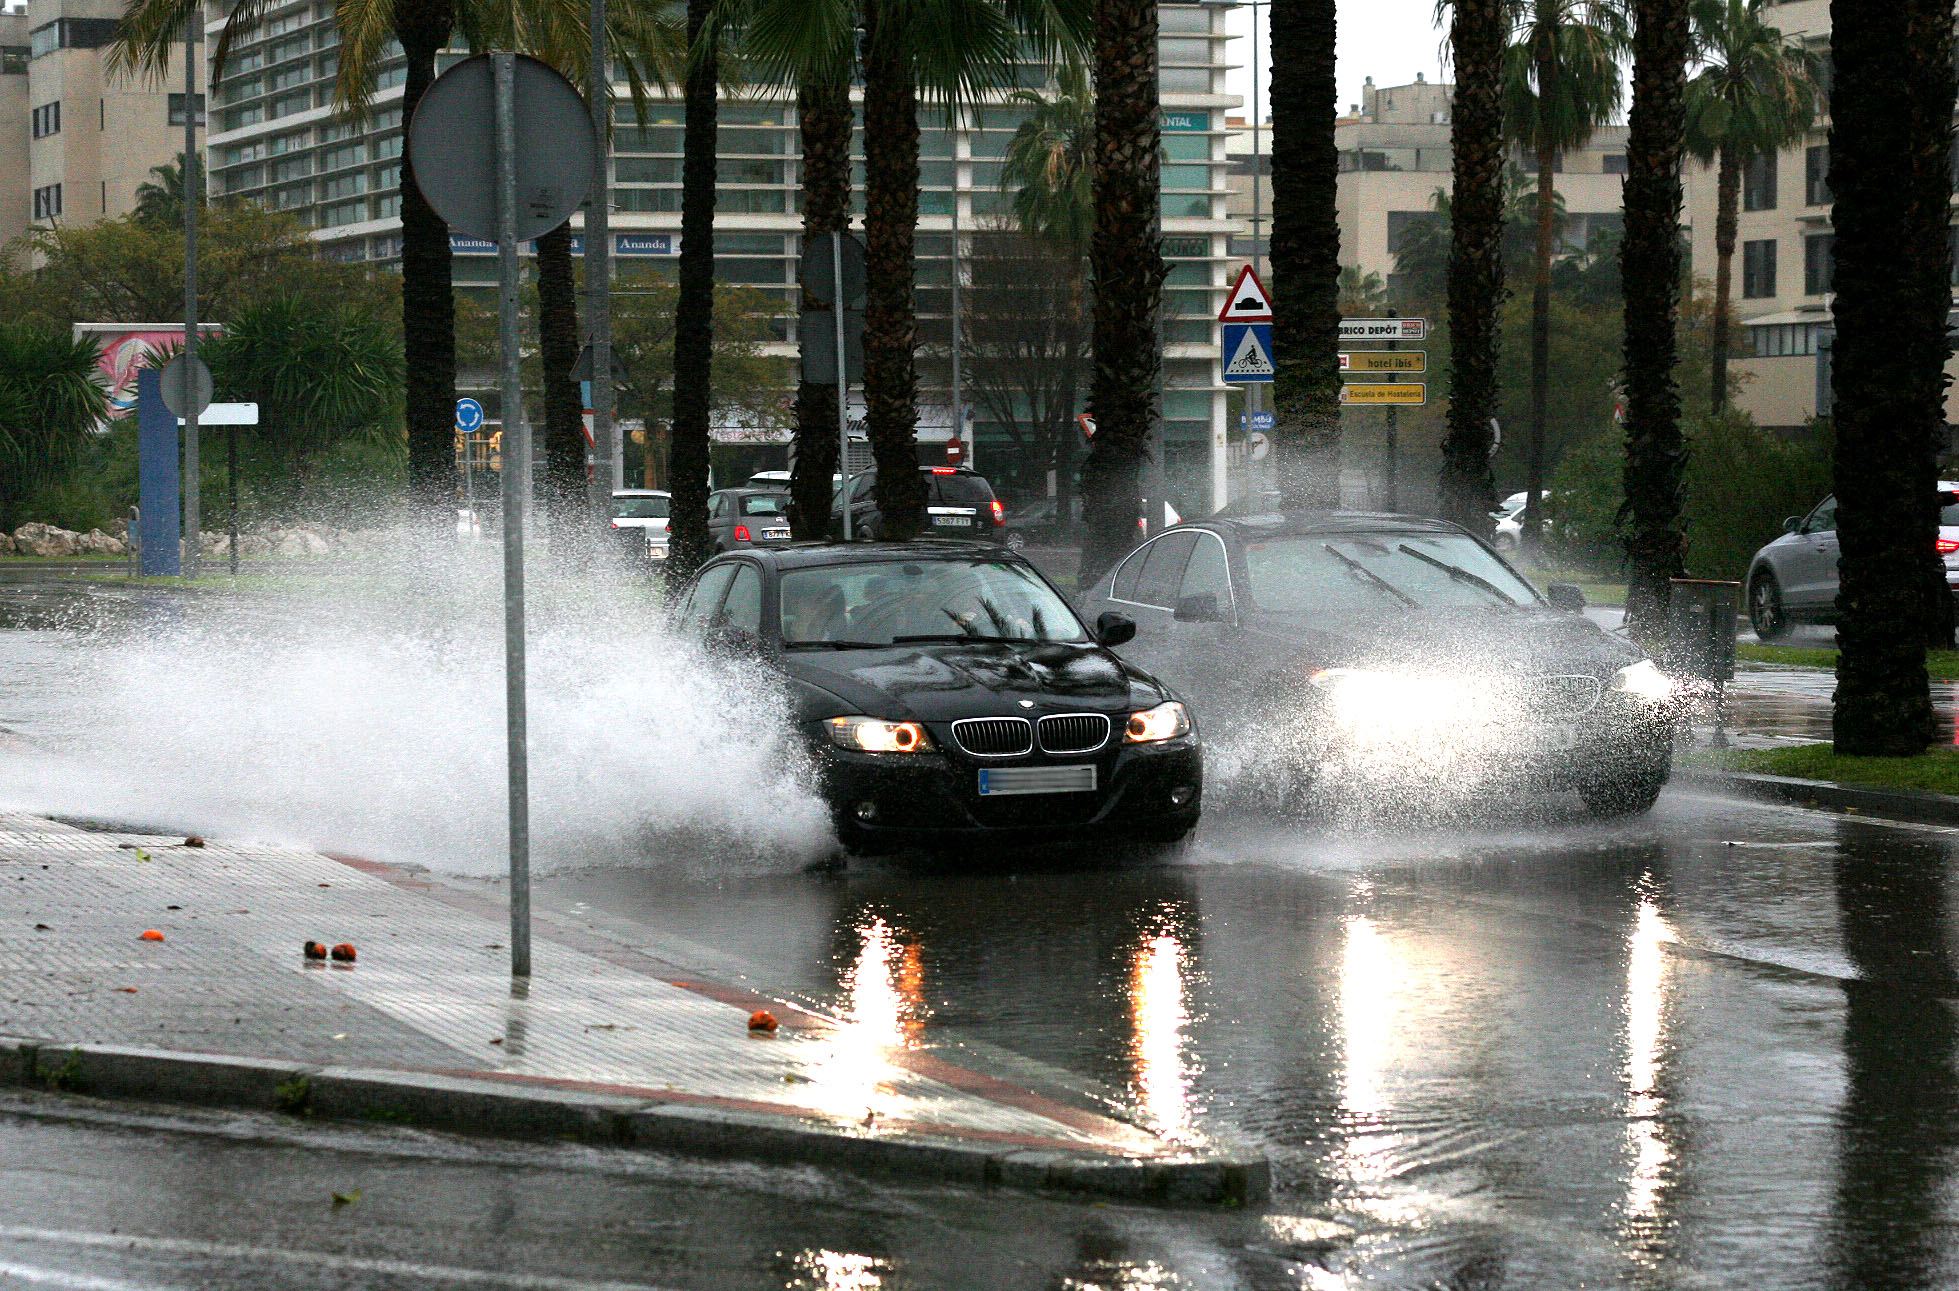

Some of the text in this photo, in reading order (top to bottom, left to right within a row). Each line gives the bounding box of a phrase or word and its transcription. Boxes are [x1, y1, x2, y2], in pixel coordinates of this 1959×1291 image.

[620, 238, 666, 249] Ananda
[1338, 324, 1398, 335] BRICO DEPÔT
[1368, 358, 1412, 368] hotel ibis
